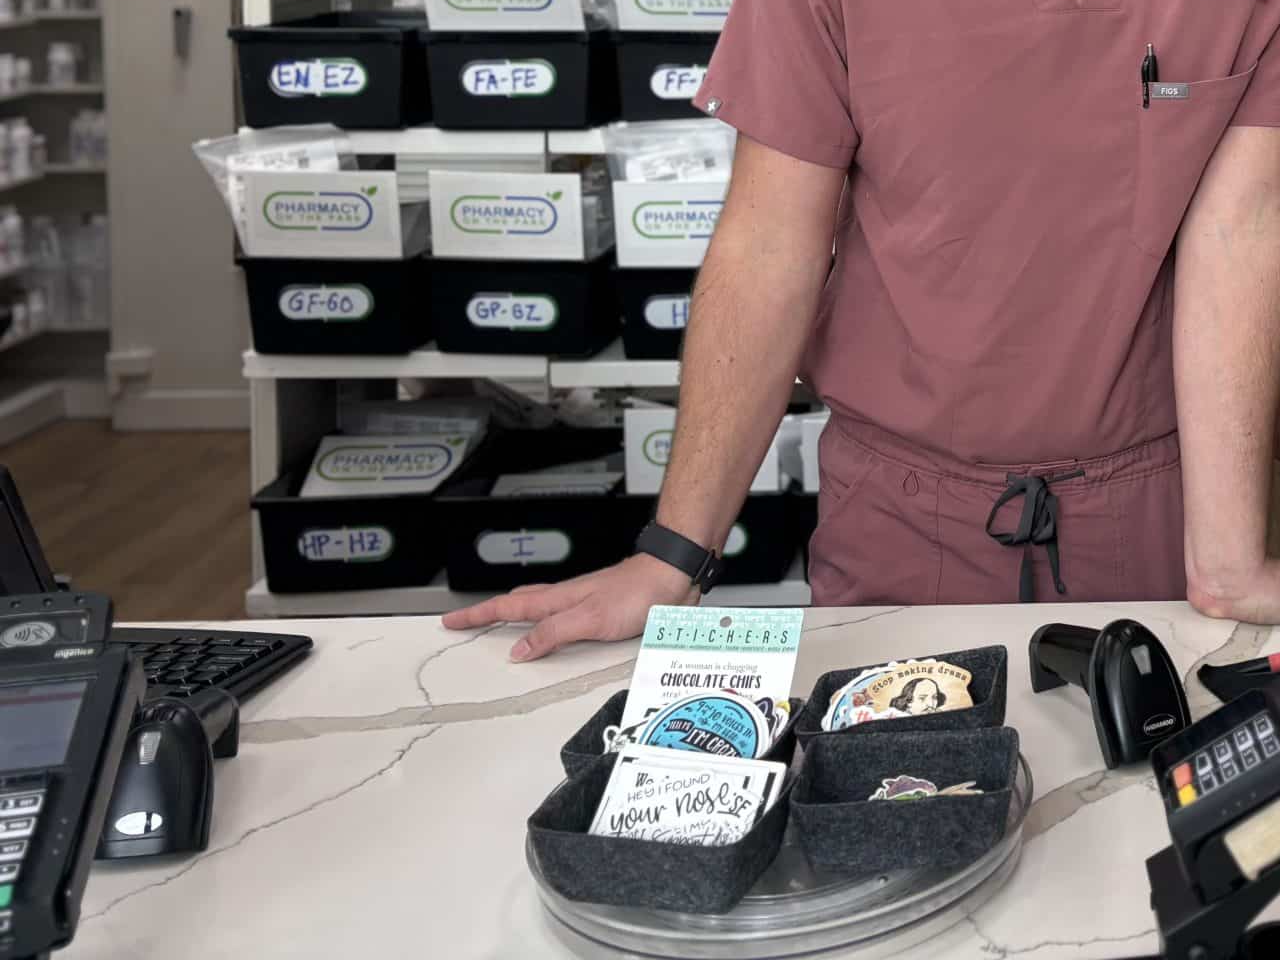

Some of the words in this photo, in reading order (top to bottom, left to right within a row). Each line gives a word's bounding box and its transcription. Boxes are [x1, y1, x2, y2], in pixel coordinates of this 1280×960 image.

[473, 68, 537, 92] FA-FE
[664, 71, 707, 93] FF-
[1160, 87, 1179, 95] FIGS
[275, 202, 361, 215] PHARMACY
[462, 206, 545, 218] PHARMACY
[644, 212, 722, 223] PHARMAC
[332, 453, 440, 466] PHARMACY
[511, 536, 535, 557] I
[660, 672, 729, 689] CHOCOLATE
[872, 675, 895, 694] Stop
[897, 665, 934, 680] making
[937, 665, 968, 682] drama
[664, 773, 711, 794] FOUND
[610, 804, 668, 838] your
[675, 782, 732, 818] nose
